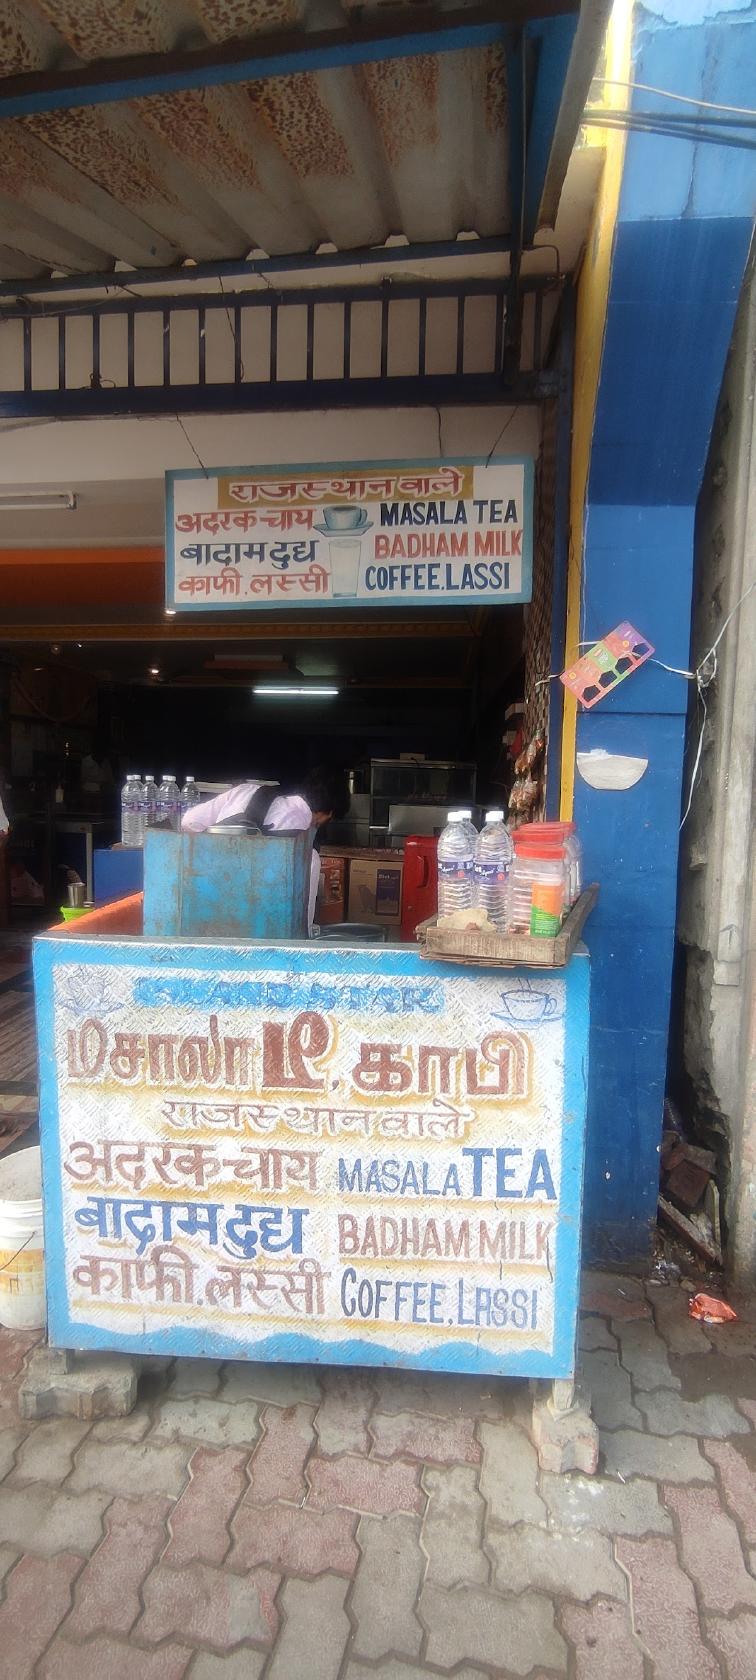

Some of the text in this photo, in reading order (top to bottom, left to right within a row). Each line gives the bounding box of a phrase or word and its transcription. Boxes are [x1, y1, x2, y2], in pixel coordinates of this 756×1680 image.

[398, 466, 464, 496] वाले
[175, 510, 257, 534] अदरक
[380, 499, 518, 527] MASALA TEA
[179, 542, 269, 566] बादाम
[374, 529, 524, 560] BADHAM MILK
[64, 1141, 220, 1190] अदरक
[337, 1147, 557, 1200] MASALA TEA
[75, 1197, 224, 1256] बादाम
[338, 1214, 553, 1260] BADHAM MILK
